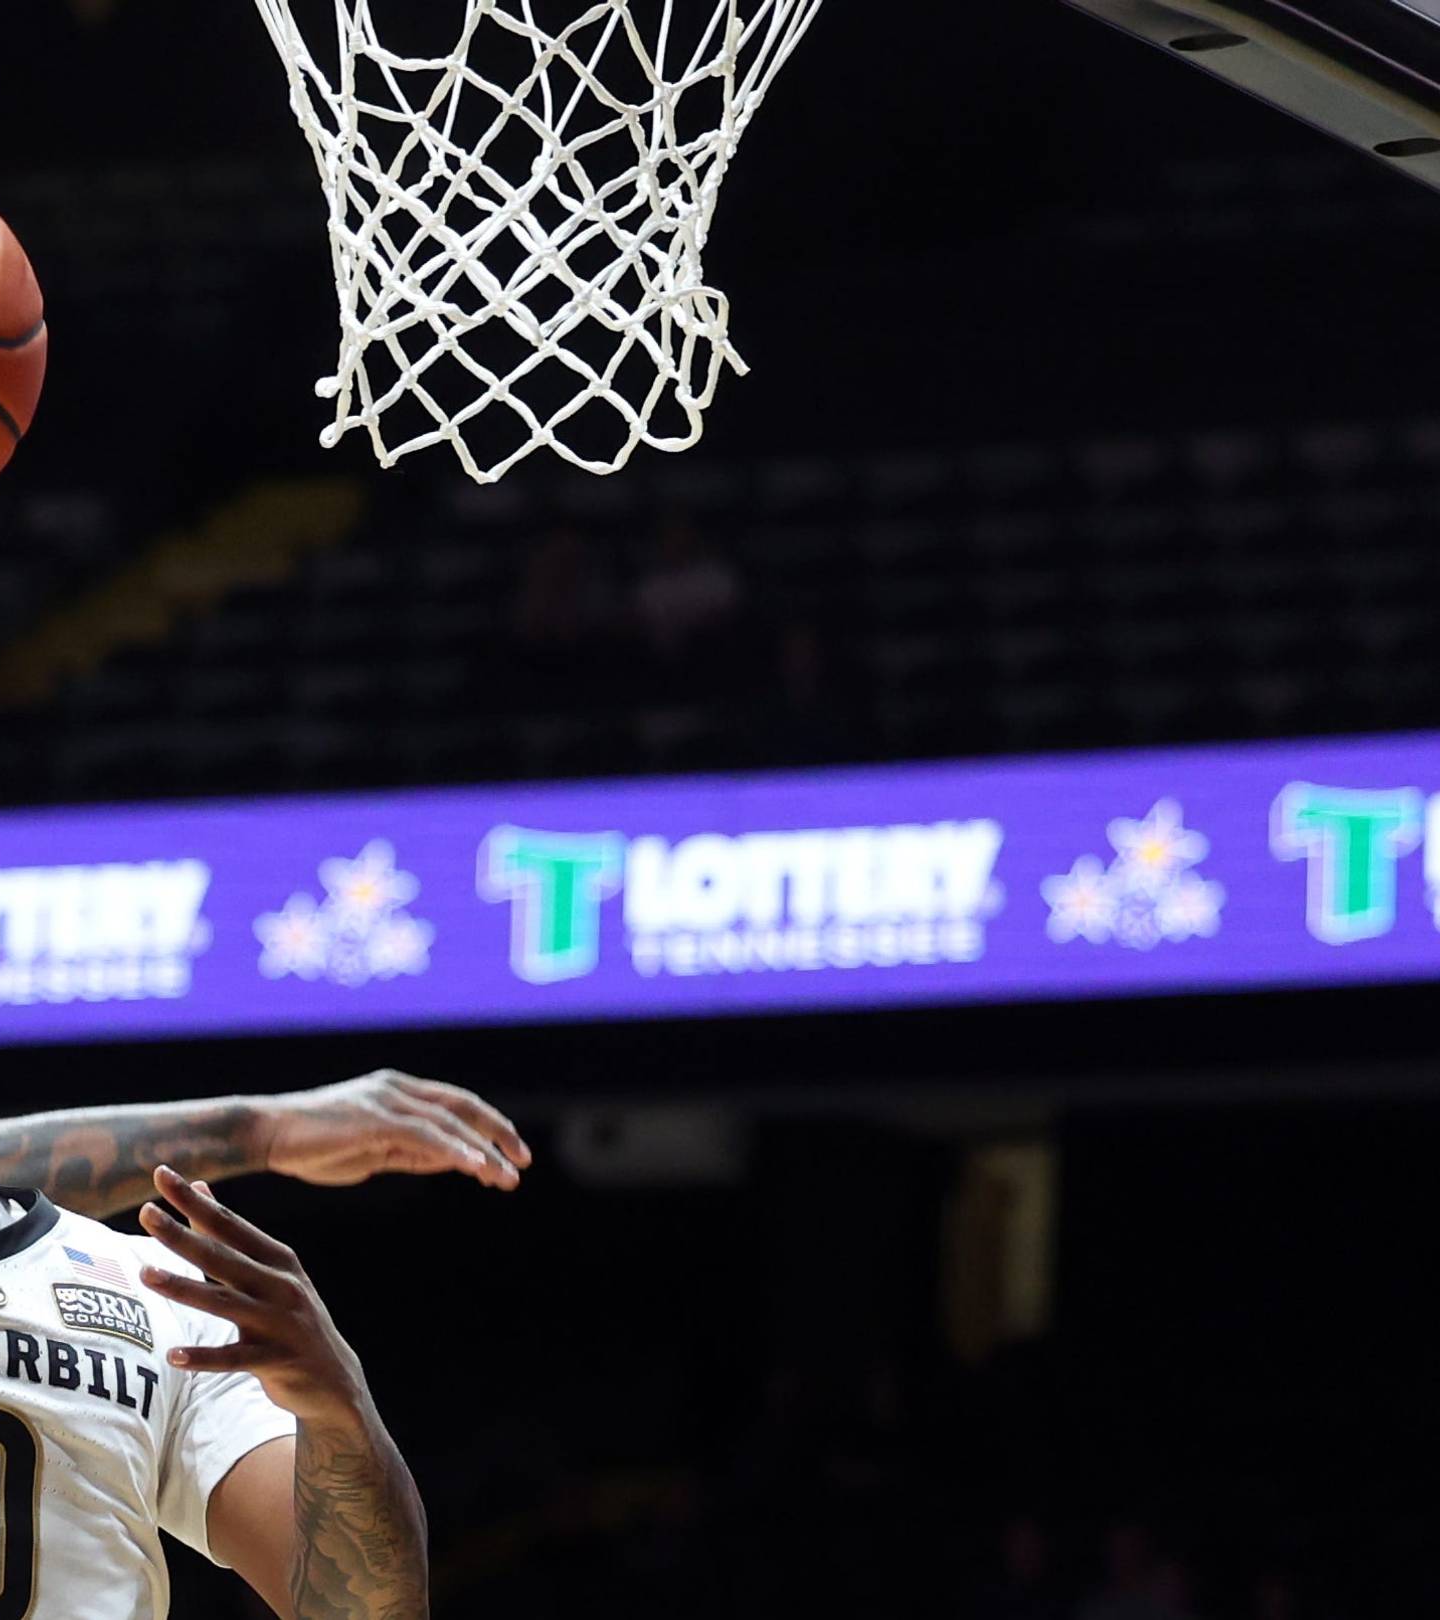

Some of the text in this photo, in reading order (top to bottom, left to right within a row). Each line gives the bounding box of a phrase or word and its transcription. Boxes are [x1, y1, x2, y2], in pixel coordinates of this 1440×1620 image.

[624, 819, 1001, 931] LOTTERY
[631, 921, 984, 974] TENNESSEE
[63, 1312, 153, 1342] CONCRETE
[77, 1288, 151, 1331] SRM
